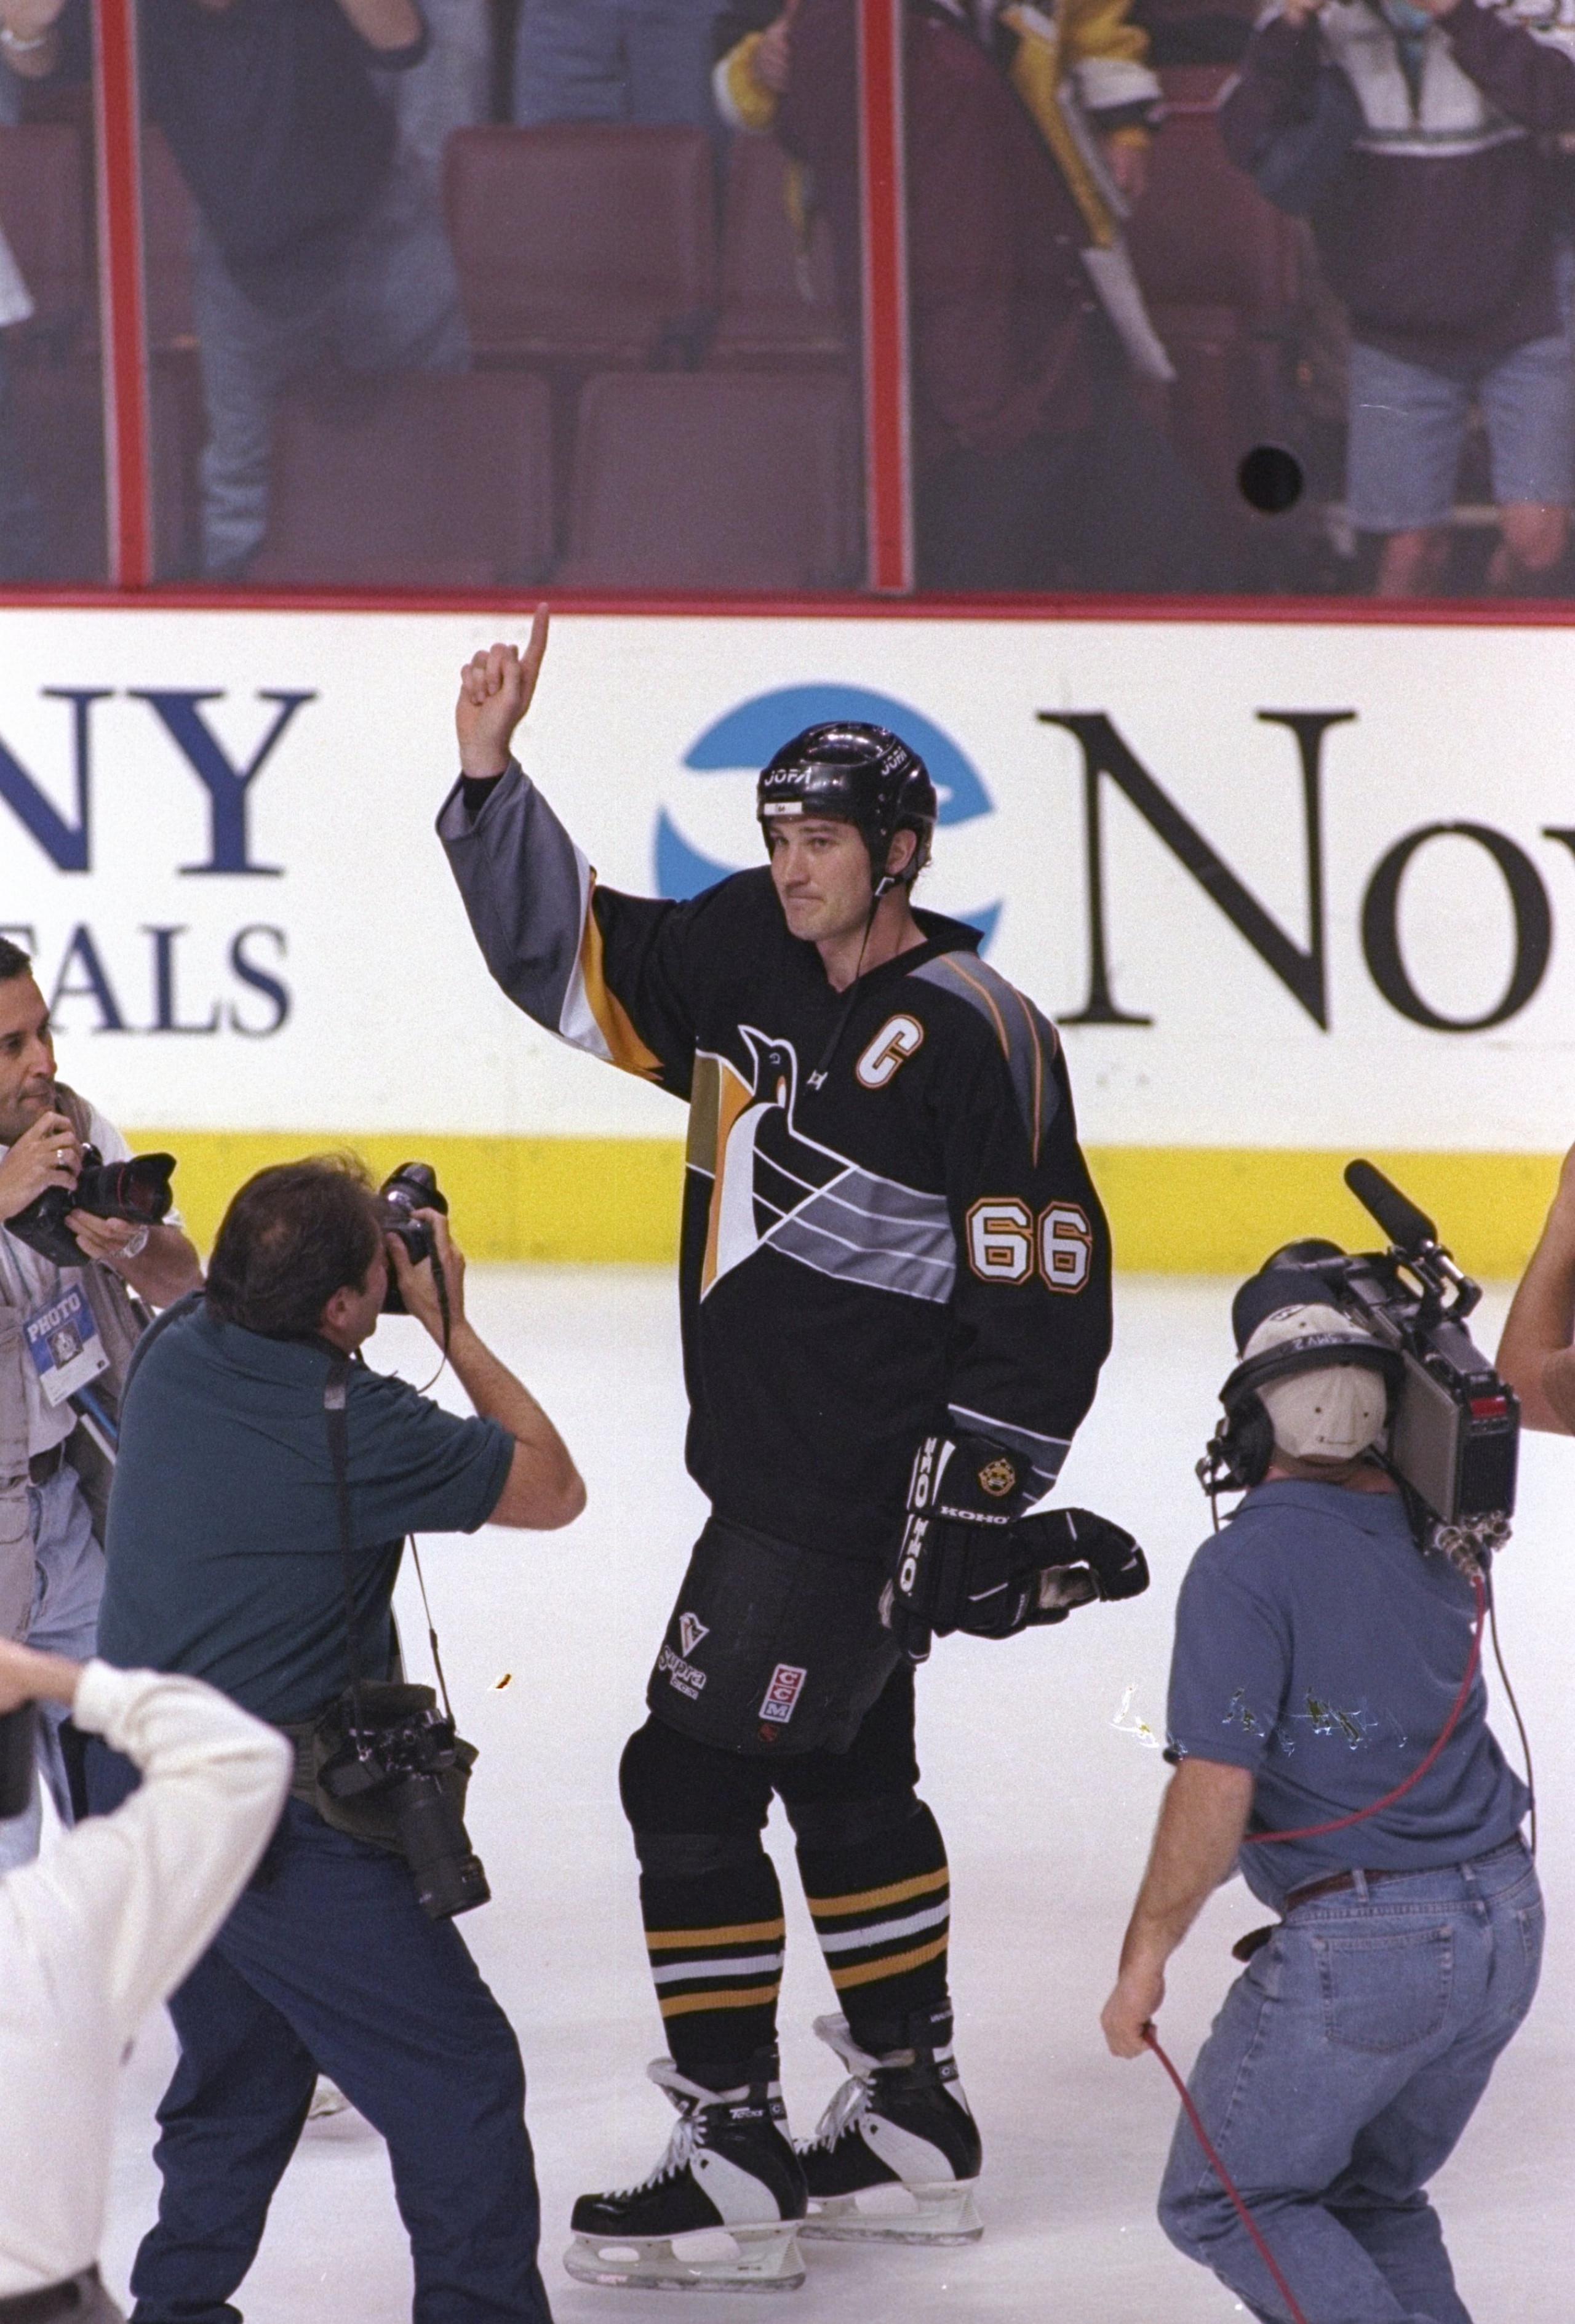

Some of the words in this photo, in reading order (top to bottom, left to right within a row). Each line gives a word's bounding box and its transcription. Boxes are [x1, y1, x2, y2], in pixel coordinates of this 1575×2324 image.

[0, 685, 319, 876] NY
[764, 767, 811, 786] JOFA
[1036, 709, 1575, 1034] No
[0, 923, 291, 1039] ALS
[856, 1014, 923, 1089] C
[965, 1197, 1093, 1294] 66
[27, 1293, 81, 1343] PHOTO
[940, 1506, 1010, 1525] KOHO
[659, 1645, 706, 1690] Supra
[767, 1671, 798, 1717] CCM
